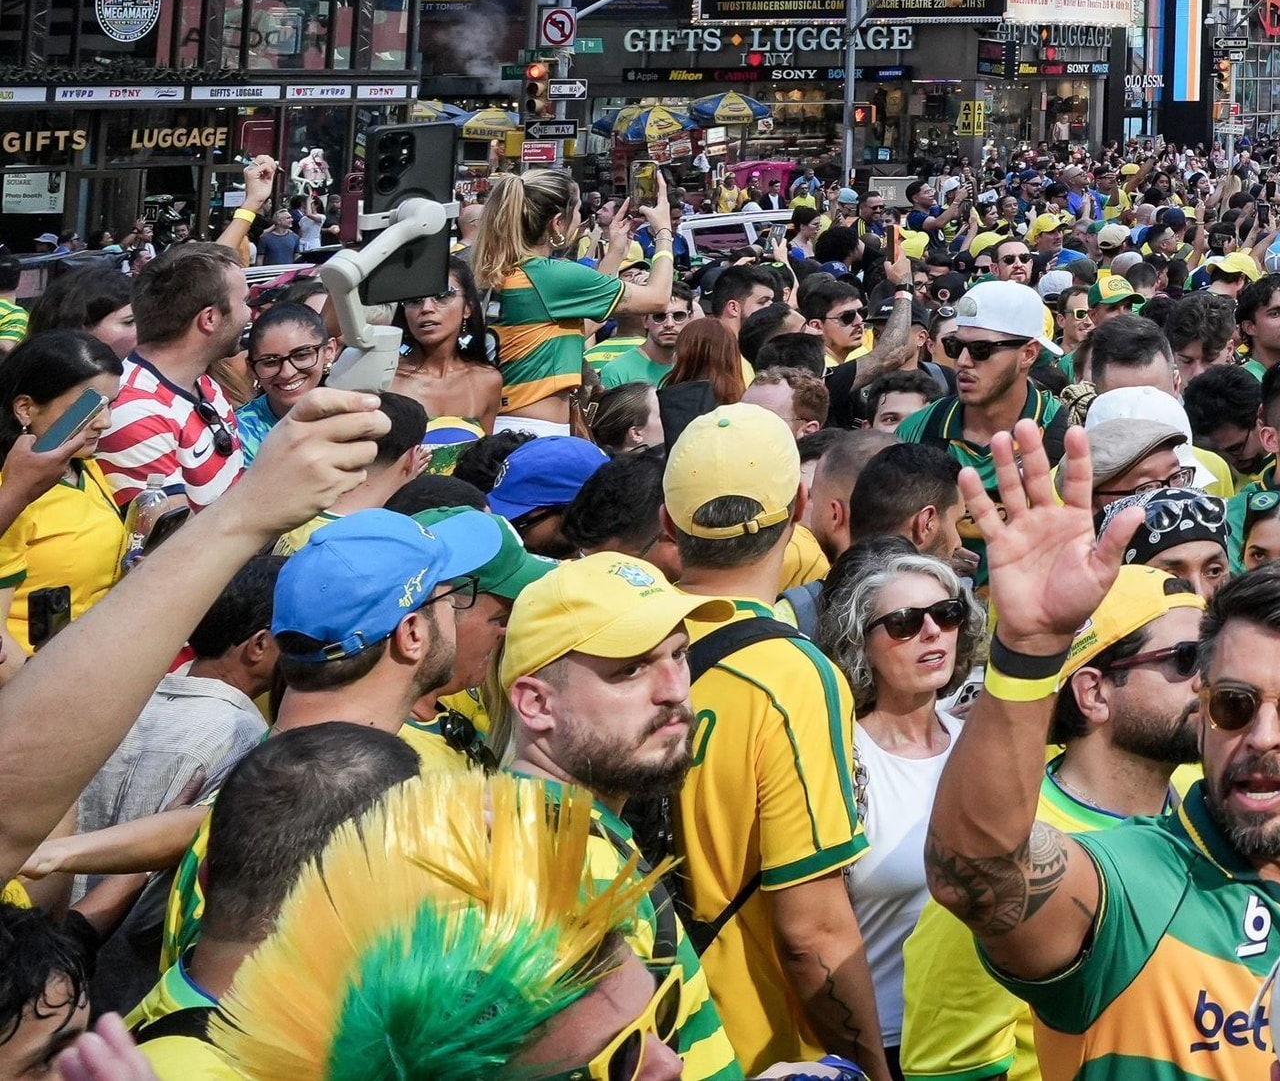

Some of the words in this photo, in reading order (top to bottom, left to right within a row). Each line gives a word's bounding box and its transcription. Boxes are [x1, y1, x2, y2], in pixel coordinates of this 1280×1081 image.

[717, 0, 845, 13] TWOSTRANGERSMUSICAL.COM
[104, 7, 153, 19] MEGAMART
[624, 27, 722, 53] GIFTS
[1051, 26, 1112, 47] LUGGAGE
[581, 40, 588, 51] 7
[1067, 63, 1089, 73] SONY
[637, 71, 659, 82] Apple
[669, 69, 703, 80] Nikon
[771, 69, 817, 80] SONY
[109, 89, 141, 98] FDNY
[236, 88, 263, 97] LUGGAGE
[552, 85, 563, 93] ONE
[569, 85, 582, 93] WAY
[533, 125, 549, 135] ONE
[554, 125, 571, 134] WAY
[3, 129, 88, 153] GIFTS
[130, 126, 229, 149] LUGGAGE
